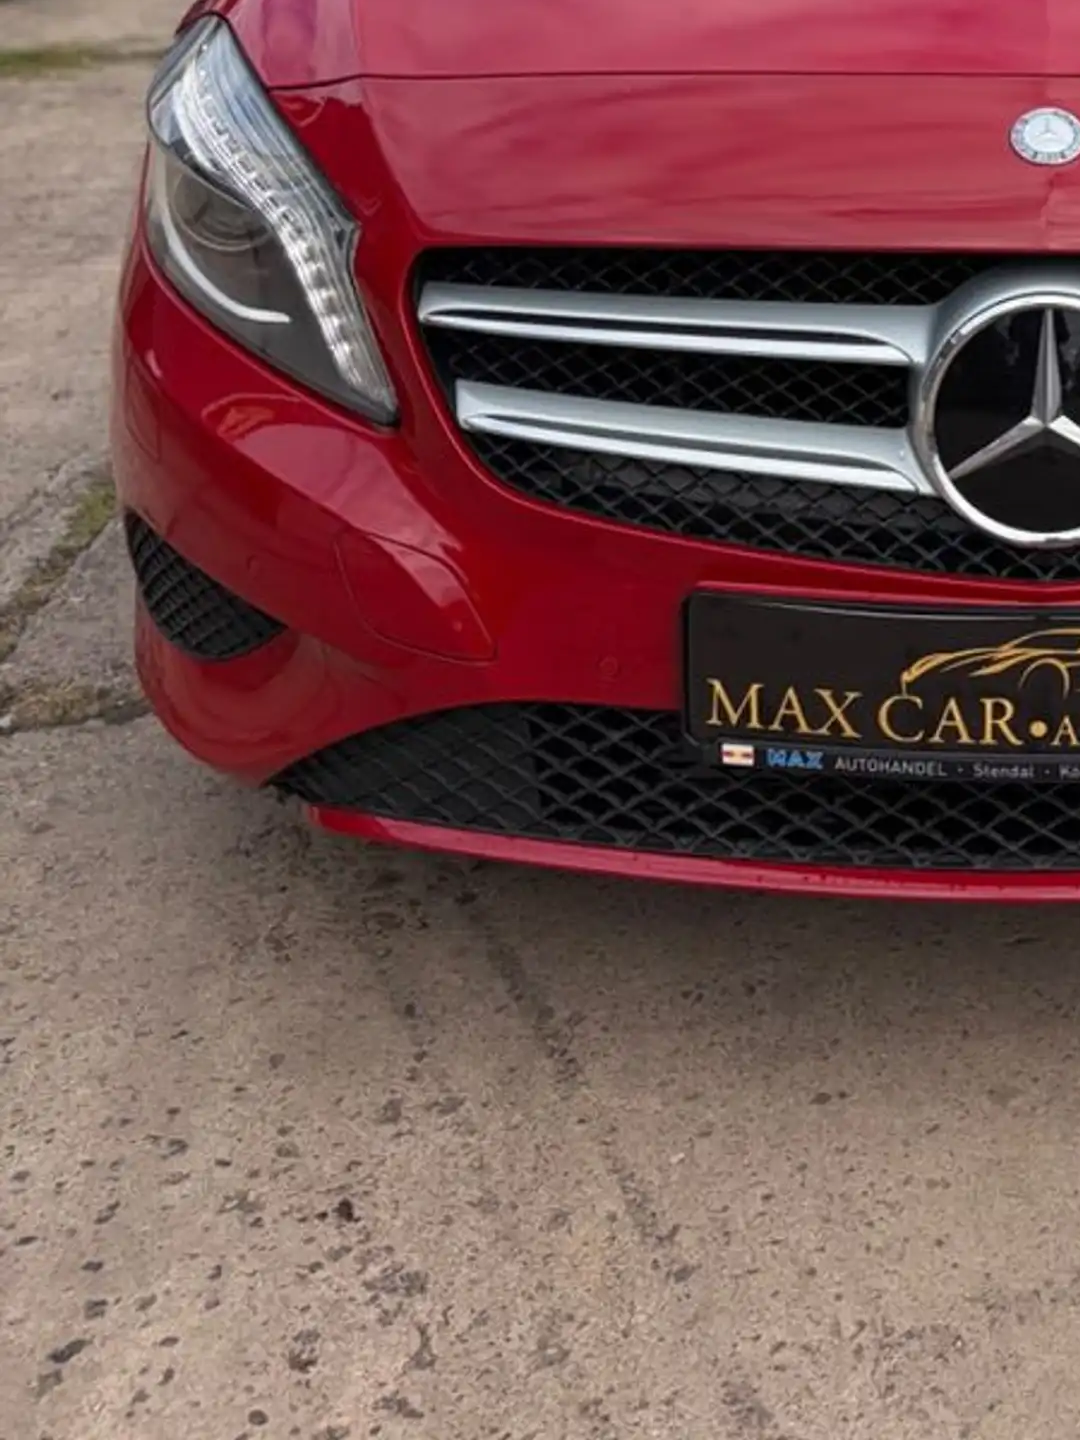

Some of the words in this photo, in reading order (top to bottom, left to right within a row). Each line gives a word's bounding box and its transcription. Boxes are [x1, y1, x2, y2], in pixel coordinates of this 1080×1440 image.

[706, 677, 862, 738] MAX
[878, 694, 1024, 745] CAR
[834, 757, 948, 777] AUTOHANDEL
[973, 763, 1034, 779] Stendal
